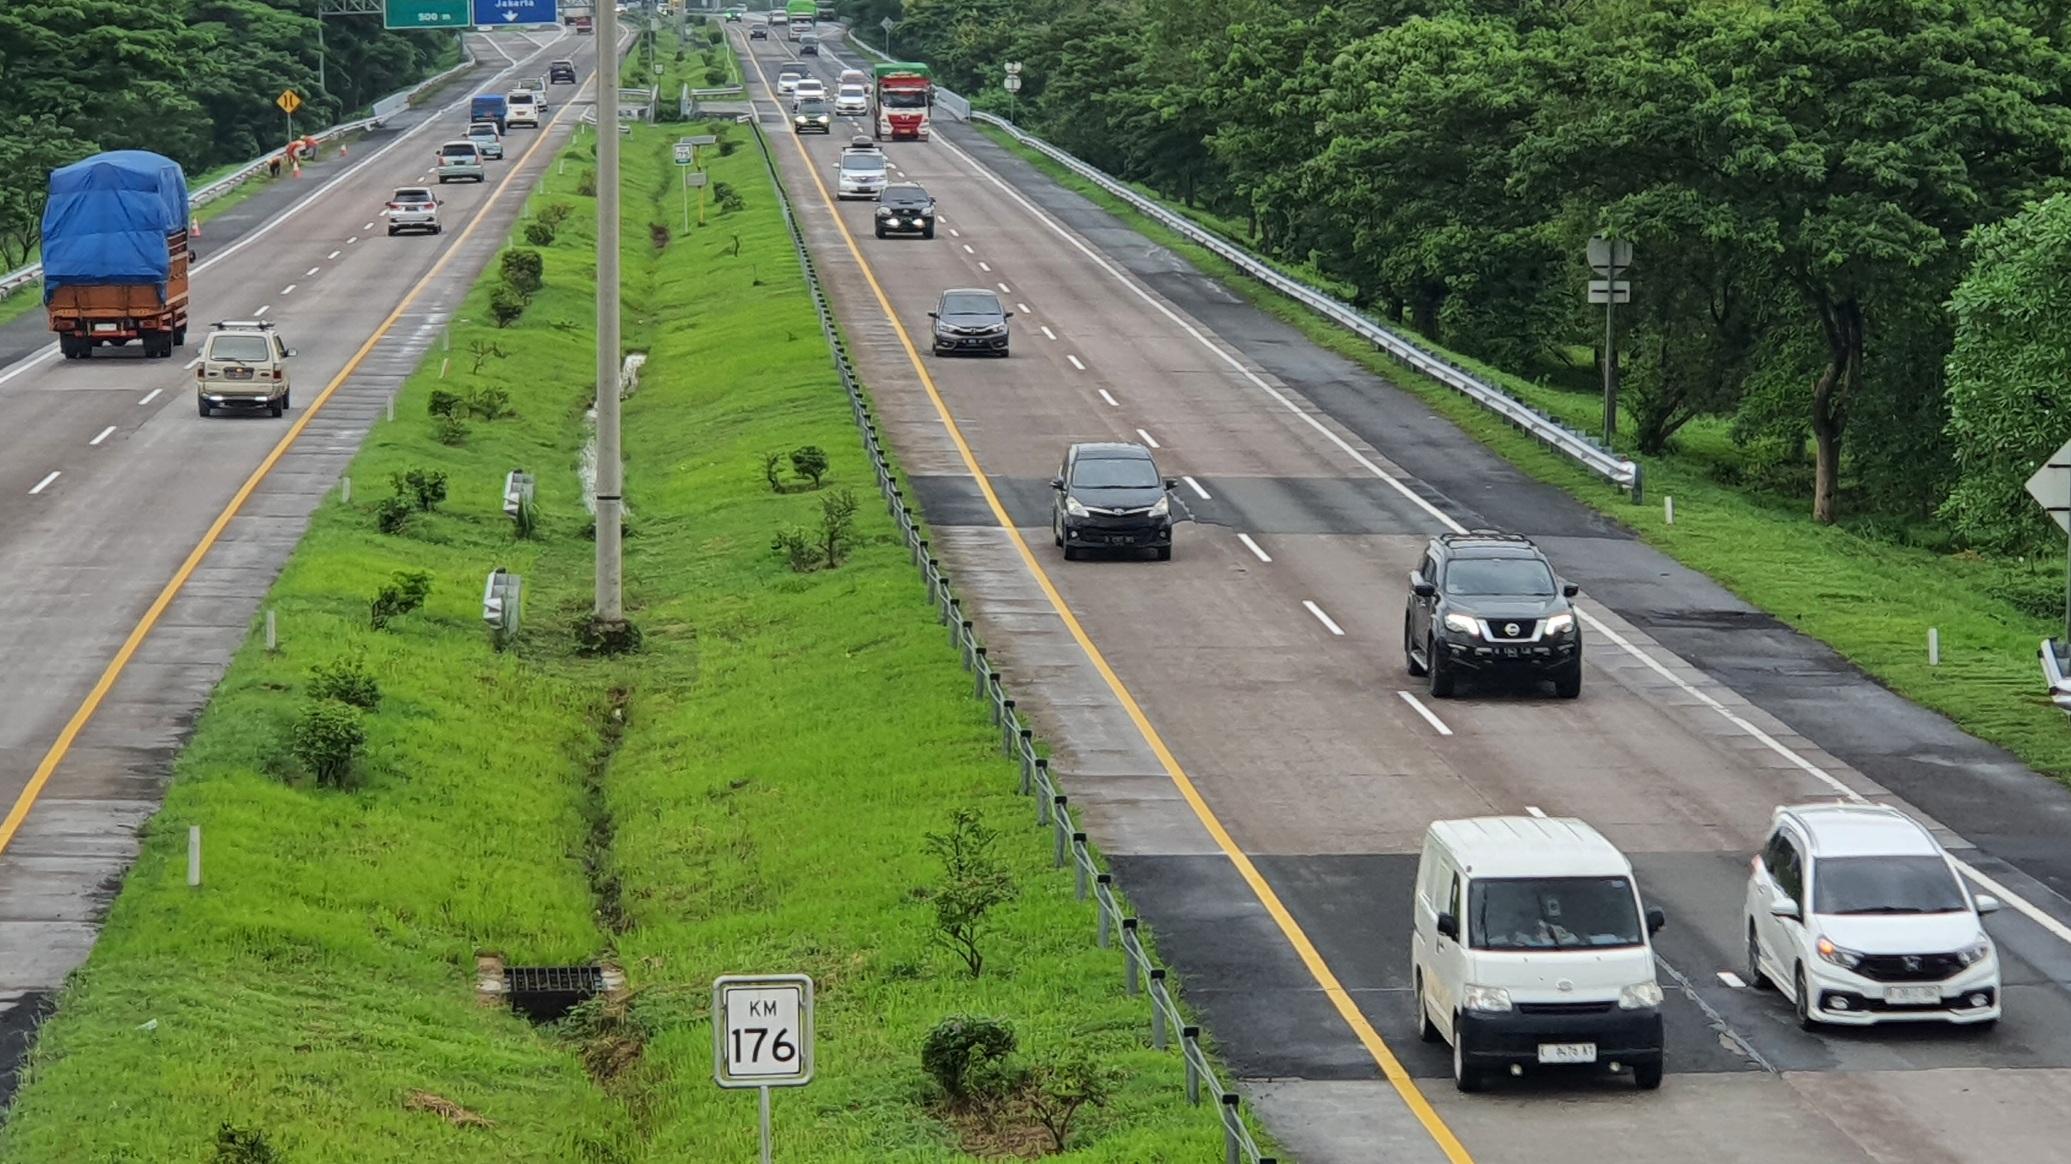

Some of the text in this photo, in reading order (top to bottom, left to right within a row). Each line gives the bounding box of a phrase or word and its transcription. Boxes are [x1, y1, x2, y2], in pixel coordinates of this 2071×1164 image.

[495, 0, 535, 8] Jakarta
[749, 1000, 777, 1017] KM
[732, 1027, 796, 1063] 176
